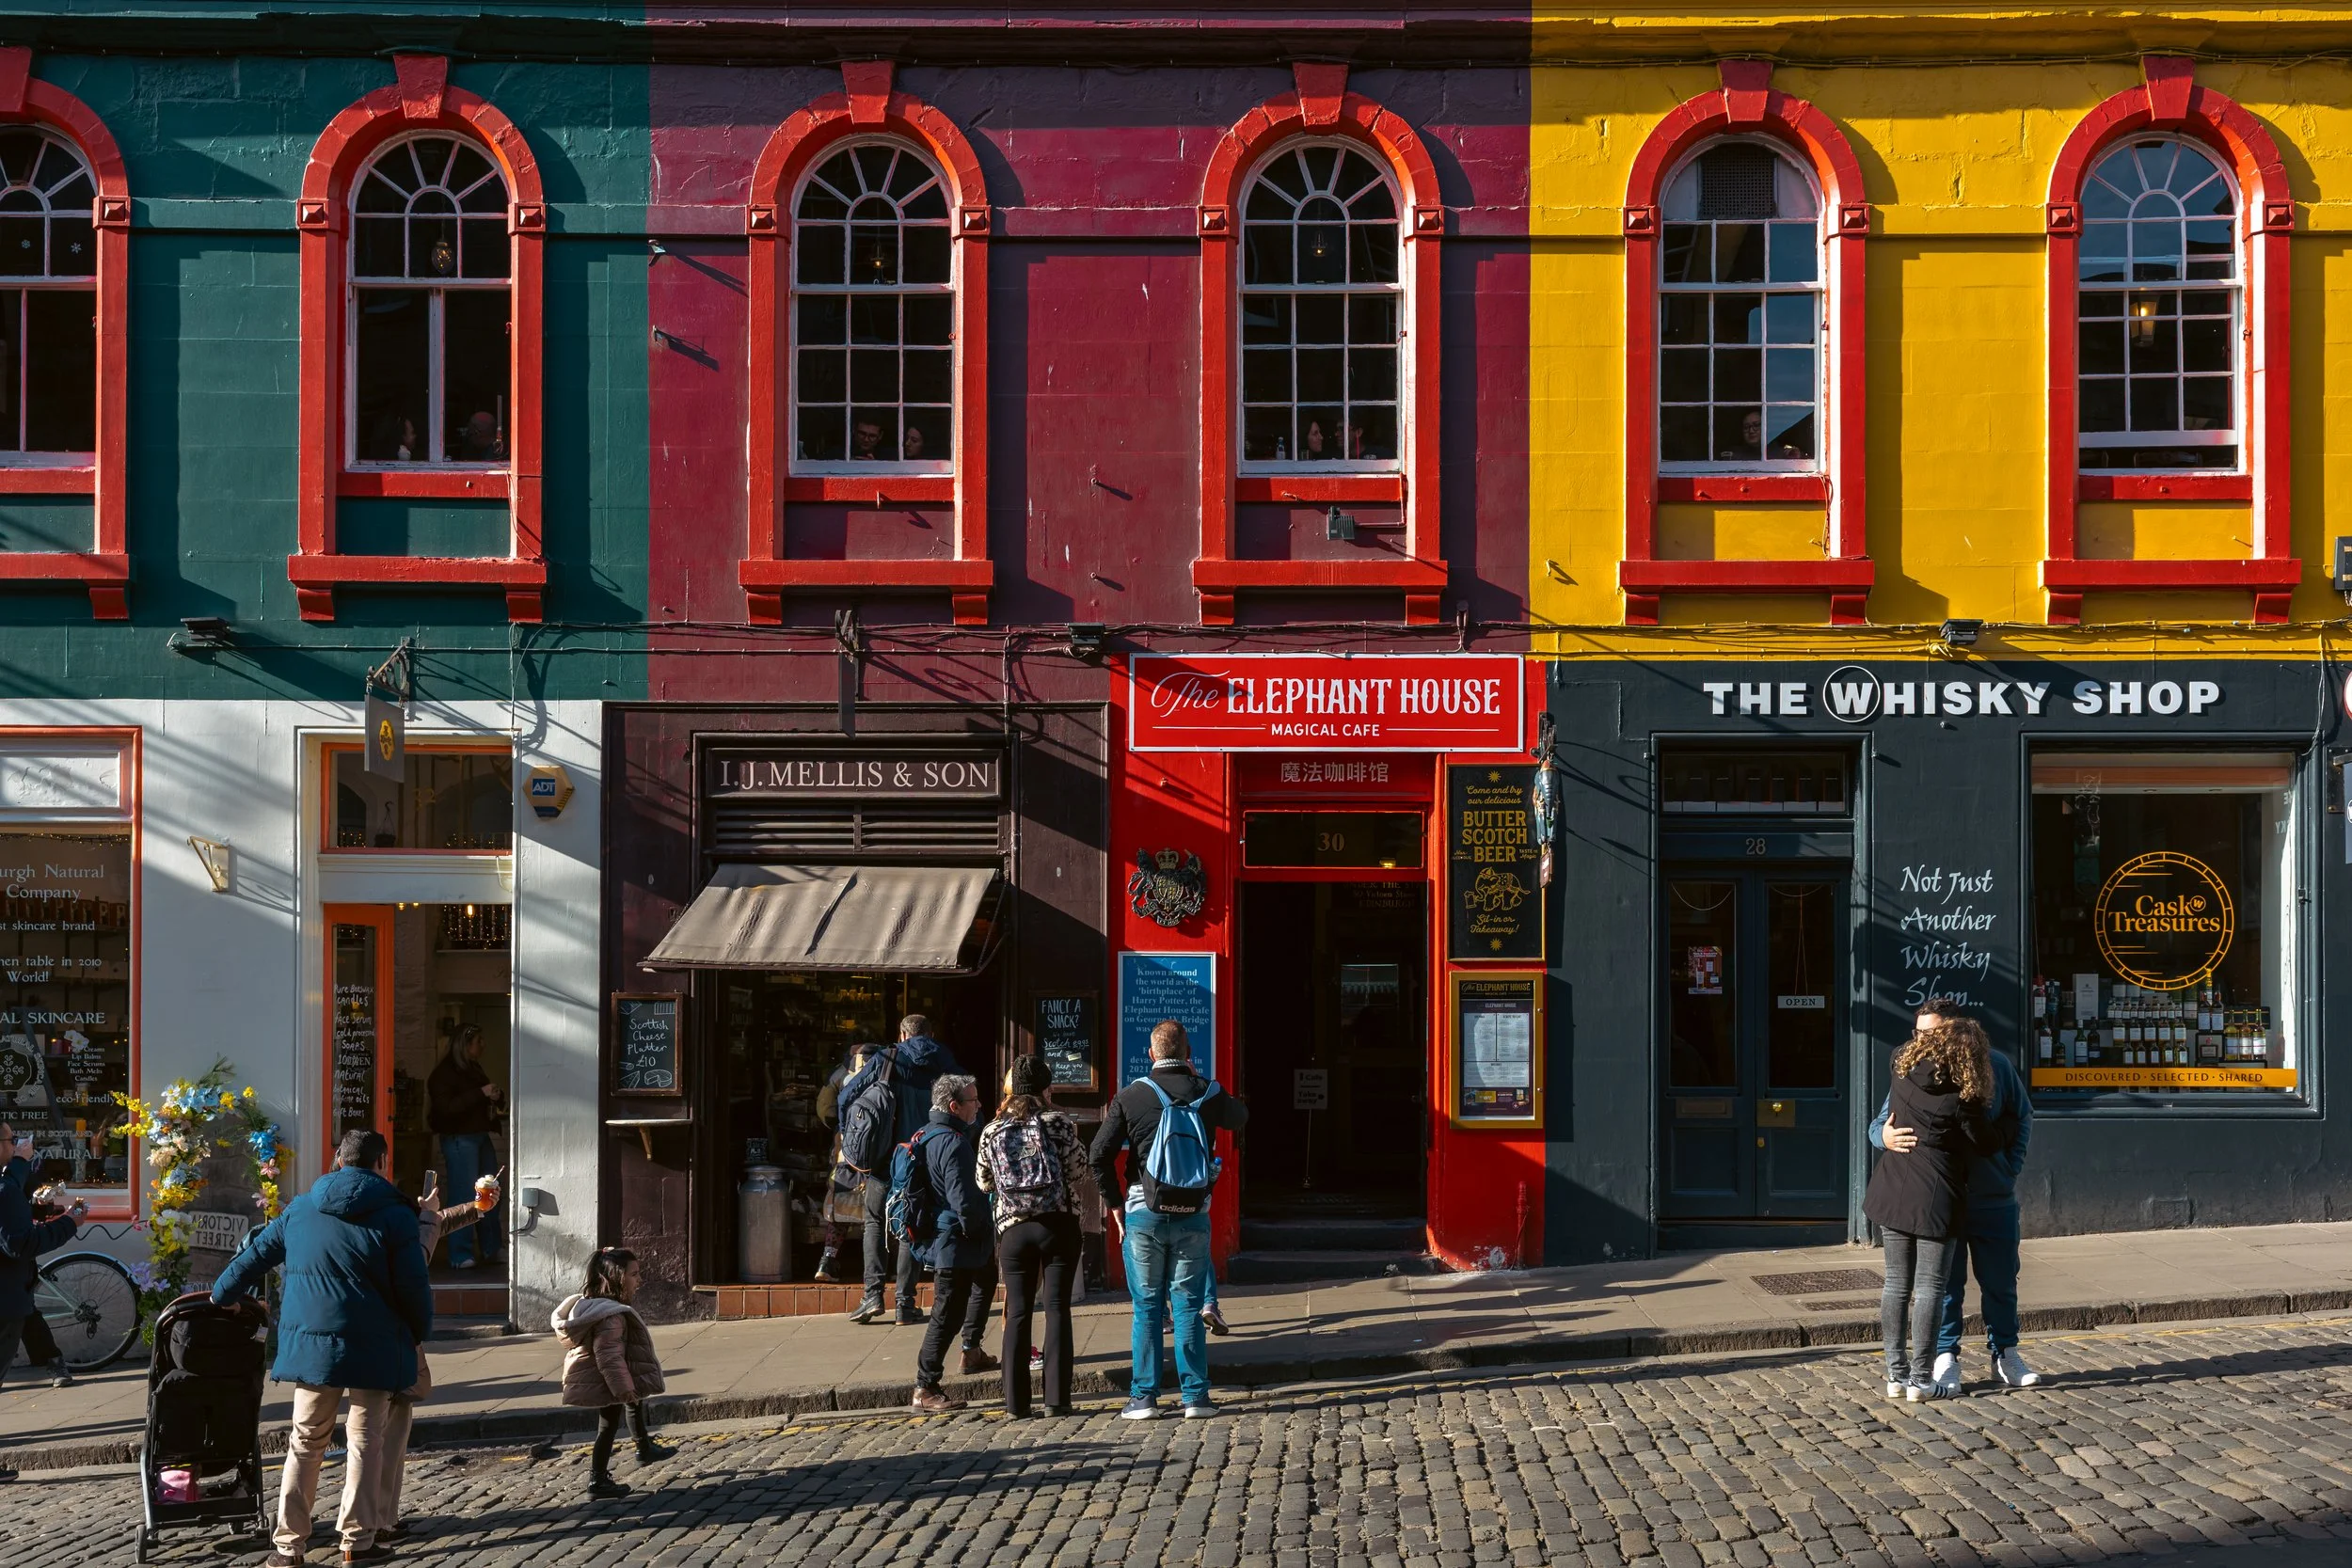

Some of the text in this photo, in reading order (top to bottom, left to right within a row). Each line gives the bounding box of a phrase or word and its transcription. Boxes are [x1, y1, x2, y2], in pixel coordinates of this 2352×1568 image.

[1151, 671, 1501, 718] The ELEPHANT HOUSE
[1703, 680, 2220, 715] THE WHISKY SHOP
[1271, 723, 1380, 736] MAGICAL CAFE
[893, 761, 913, 787] &
[924, 760, 990, 787] SON
[1280, 762, 1389, 783] 魔法咖啡馆
[533, 782, 555, 792] ADT
[1467, 785, 1523, 795] Come and try
[1484, 796, 1521, 804] delicious
[1463, 810, 1527, 827] BUTTER
[1317, 832, 1345, 851] 30
[1462, 828, 1527, 845] SCOTCH
[1745, 838, 1766, 855] 28
[1474, 846, 1517, 863] BEER
[44, 863, 104, 879] Natural
[1900, 864, 1994, 904] Not Just
[6, 883, 81, 903] Company
[2136, 895, 2194, 916] Cask
[1477, 913, 1502, 925] Sit-in
[1900, 905, 1996, 931] Another
[2107, 911, 2220, 932] Treasures
[12, 921, 56, 931] skincare
[62, 920, 95, 931] brand
[1470, 924, 1519, 935] Takeaway!
[26, 955, 55, 966] table
[61, 956, 72, 966] in
[1900, 941, 1991, 982] Whisky
[7, 971, 49, 982] World!
[1137, 968, 1198, 976] Known around
[1136, 977, 1149, 986] the
[1151, 977, 1174, 986] world
[1186, 977, 1199, 986] the
[1476, 983, 1509, 991] ELEPHANT
[1510, 983, 1531, 991] HOUSE
[1138, 987, 1197, 996] 'birthplace' of
[1041, 999, 1081, 1014] FANCY A
[1132, 996, 1202, 1006] Harry Potter, the
[1124, 1006, 1210, 1015] Elephant House Cafe
[27, 1012, 106, 1023] SKINCARE
[1047, 1014, 1079, 1028] SNACK?
[1182, 1015, 1210, 1024] Bridge
[628, 1018, 669, 1030] Scottish
[632, 1030, 666, 1041] Cheese
[627, 1042, 667, 1054] Platter
[1043, 1037, 1089, 1049] Scotch eggs
[636, 1054, 656, 1067] £10
[2065, 1072, 2263, 1082] DISCOVERED SELECTED SHARED
[22, 1111, 48, 1119] FREE
[34, 1148, 102, 1159] NATURAL
[1159, 1204, 1195, 1213] adidas
